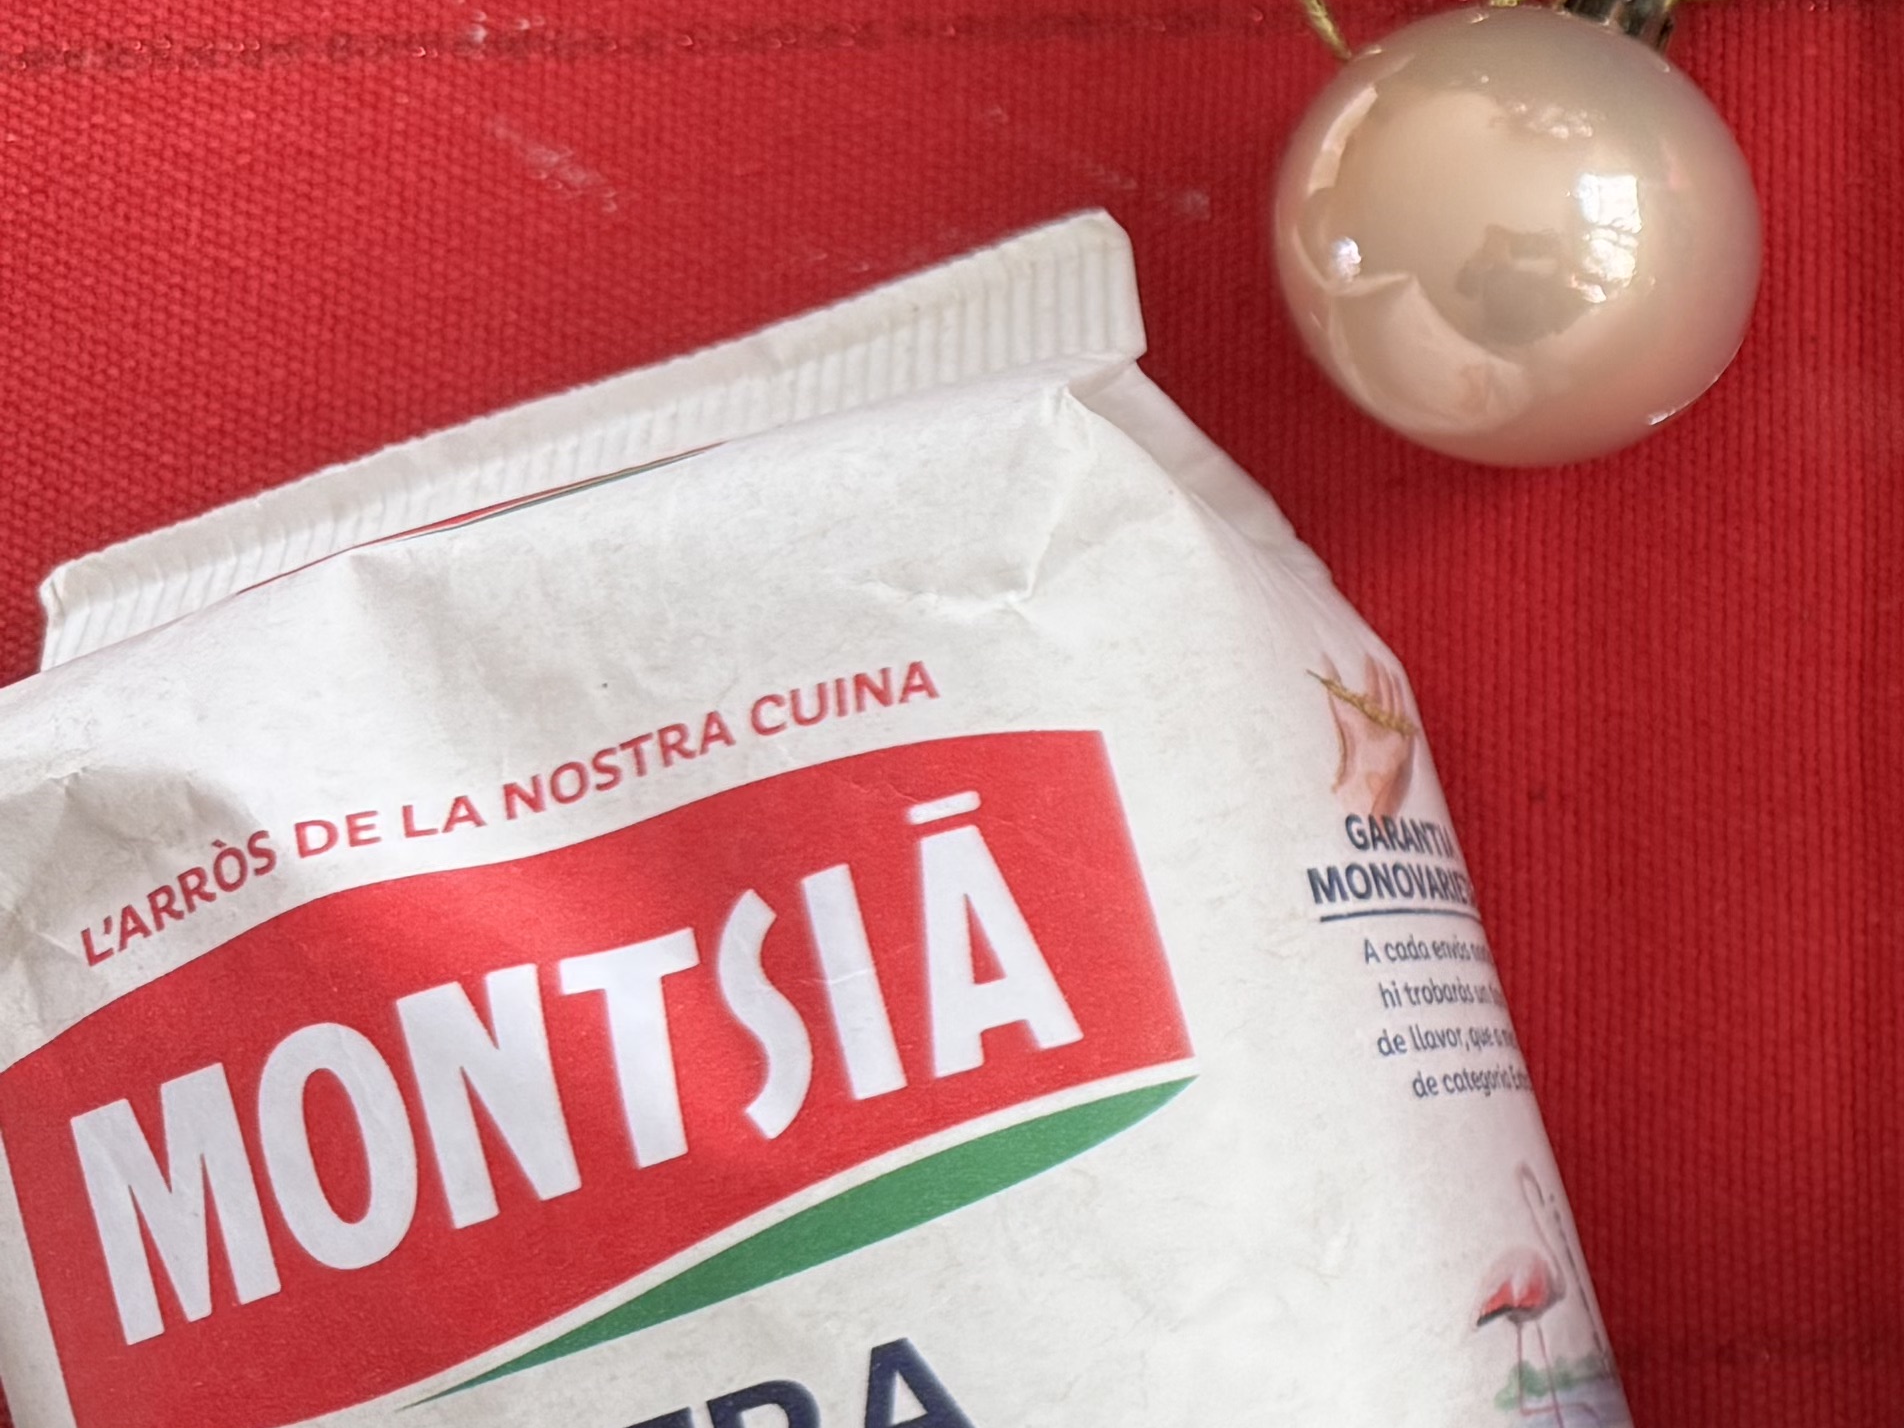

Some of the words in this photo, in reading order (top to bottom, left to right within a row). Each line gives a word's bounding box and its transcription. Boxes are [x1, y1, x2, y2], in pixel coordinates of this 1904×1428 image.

[80, 829, 278, 968] L'ARRÒS
[294, 809, 381, 859] DE
[400, 795, 487, 840] LA
[502, 711, 735, 820] NOSTRA
[749, 660, 940, 737] CUINA
[1363, 938, 1380, 964] A
[1385, 934, 1431, 962] cada
[1379, 980, 1402, 1008] hi
[1404, 977, 1474, 1007] trobaràs
[1377, 1028, 1407, 1056] de
[1409, 1024, 1469, 1052] llavor,
[1412, 1070, 1438, 1099] de
